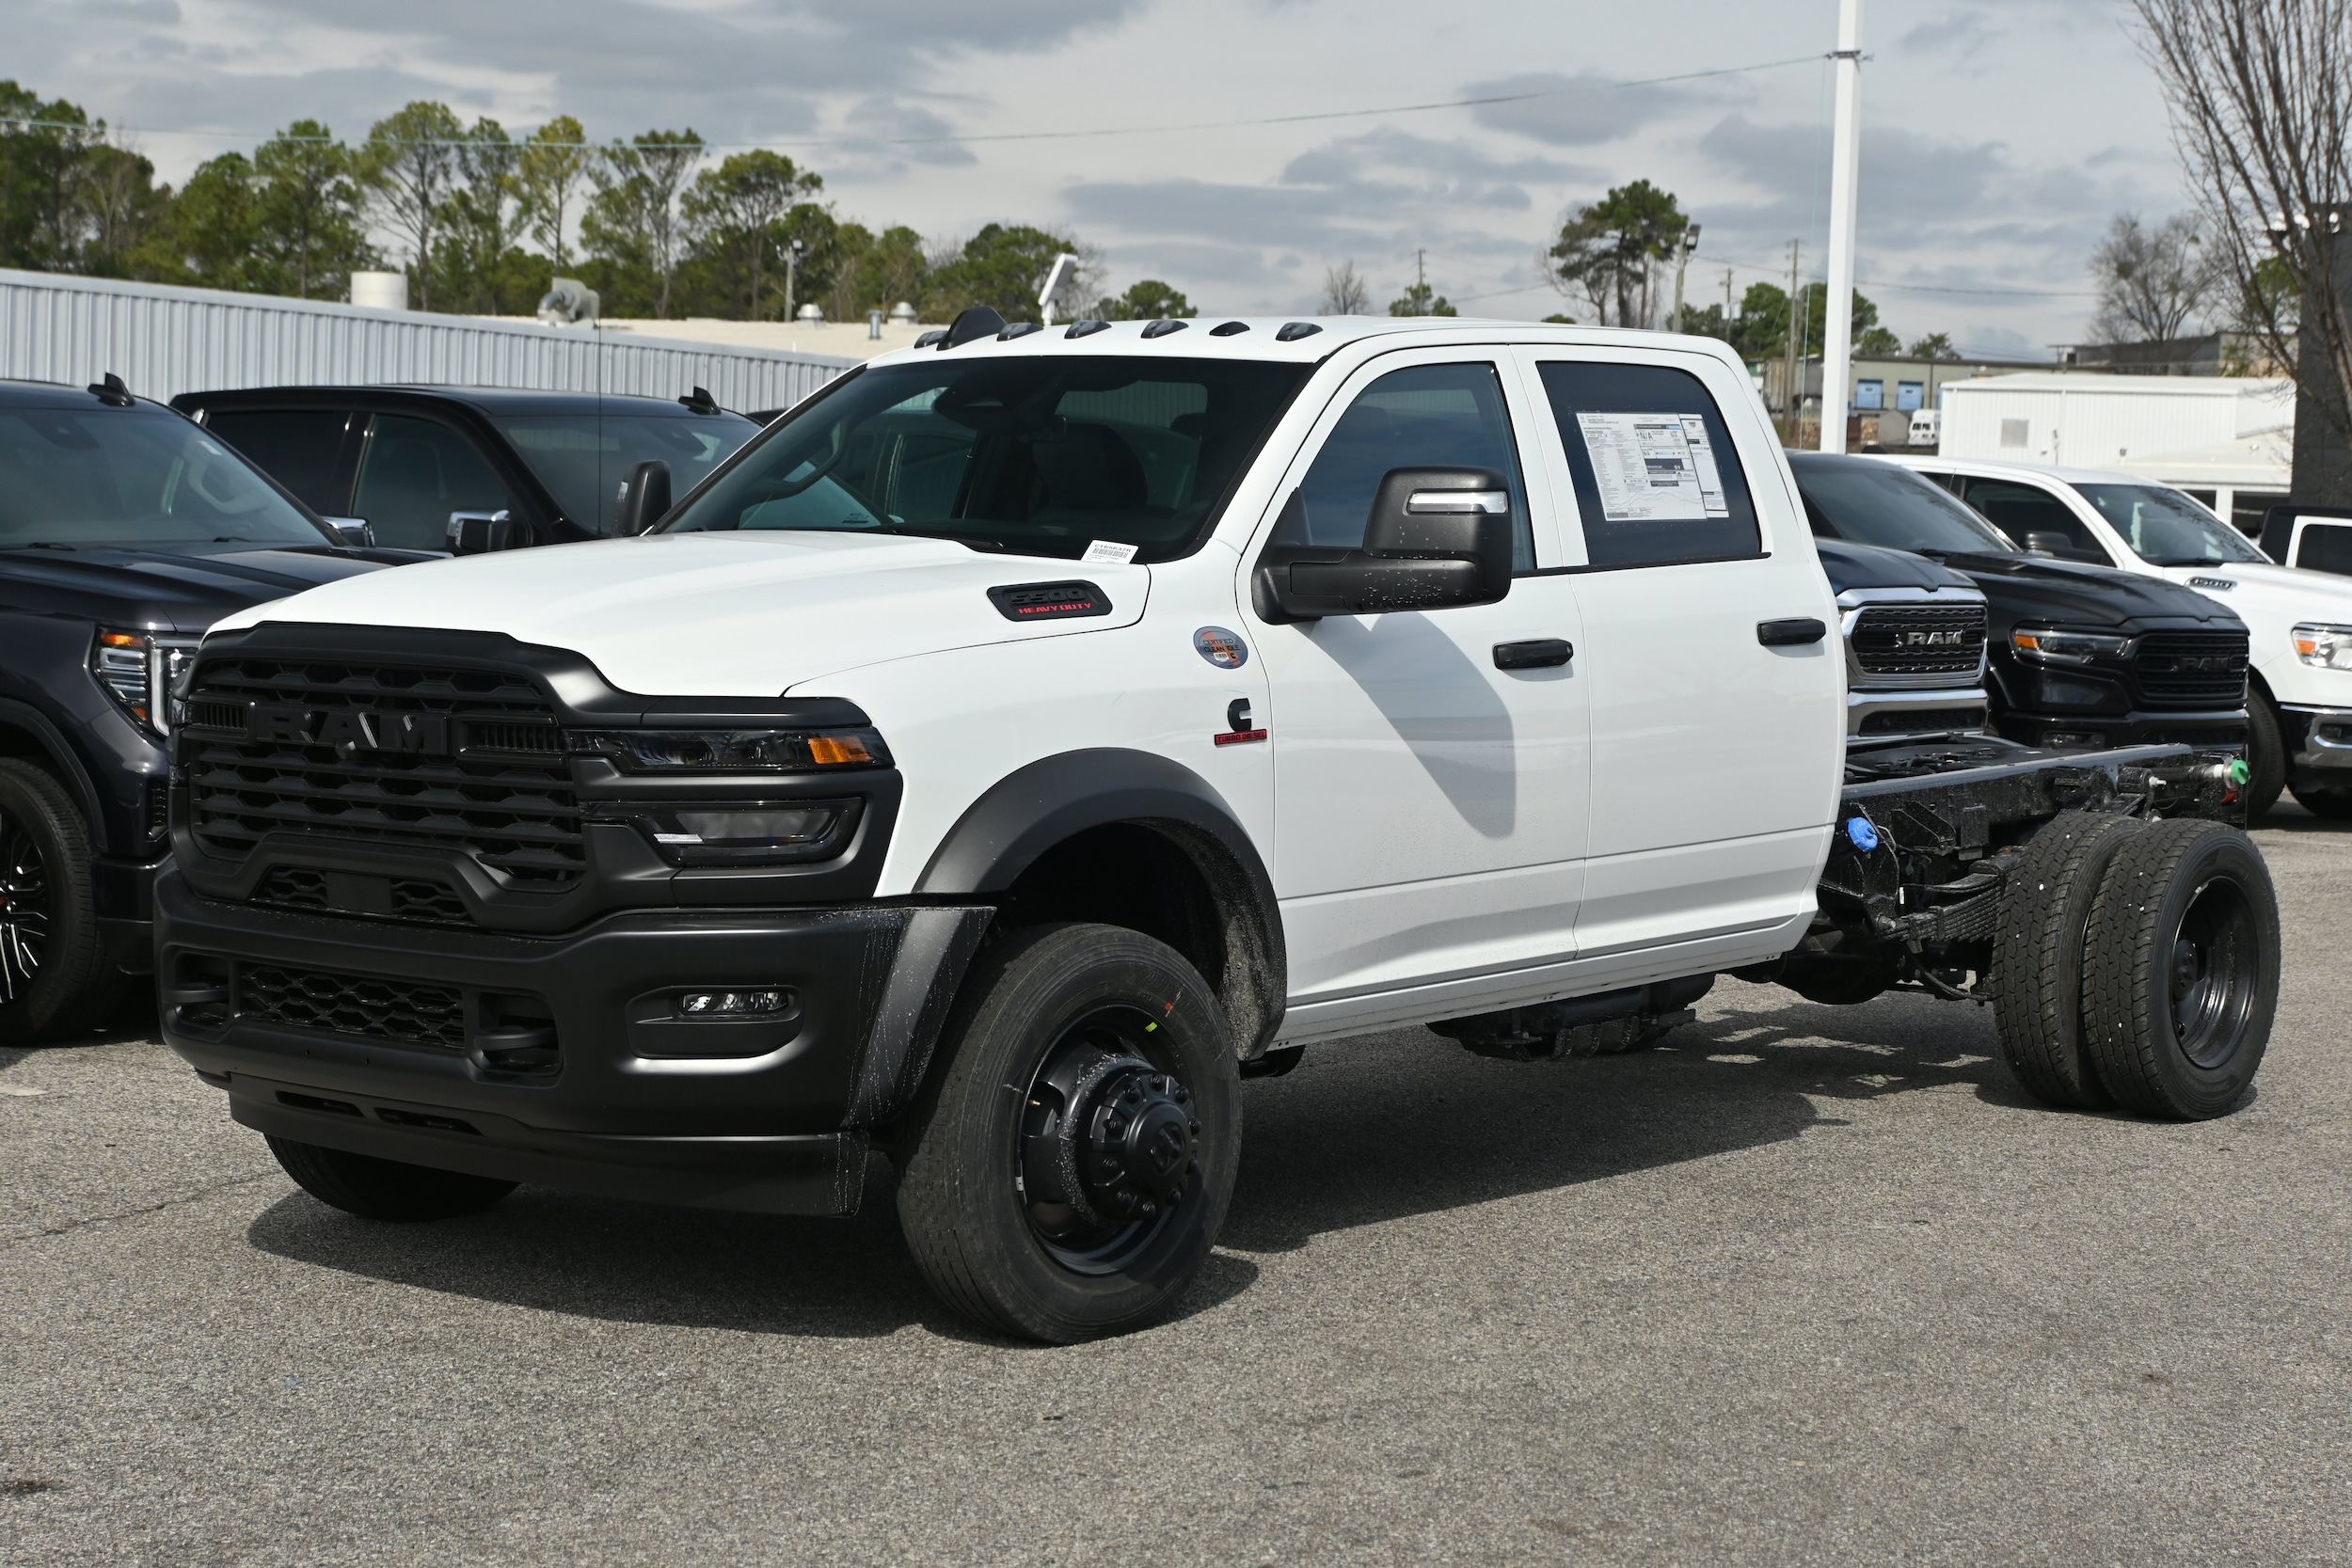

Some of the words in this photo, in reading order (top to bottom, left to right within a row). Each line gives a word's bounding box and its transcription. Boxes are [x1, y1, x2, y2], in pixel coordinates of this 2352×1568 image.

[1009, 587, 1086, 605] 5500
[1018, 605, 1058, 614] HEAVY
[1059, 603, 1091, 611] DUTY
[1907, 631, 1963, 645] RAM
[256, 704, 448, 755] RAM
[1217, 734, 1241, 743] TURBO
[1242, 731, 1265, 740] DIESEL
